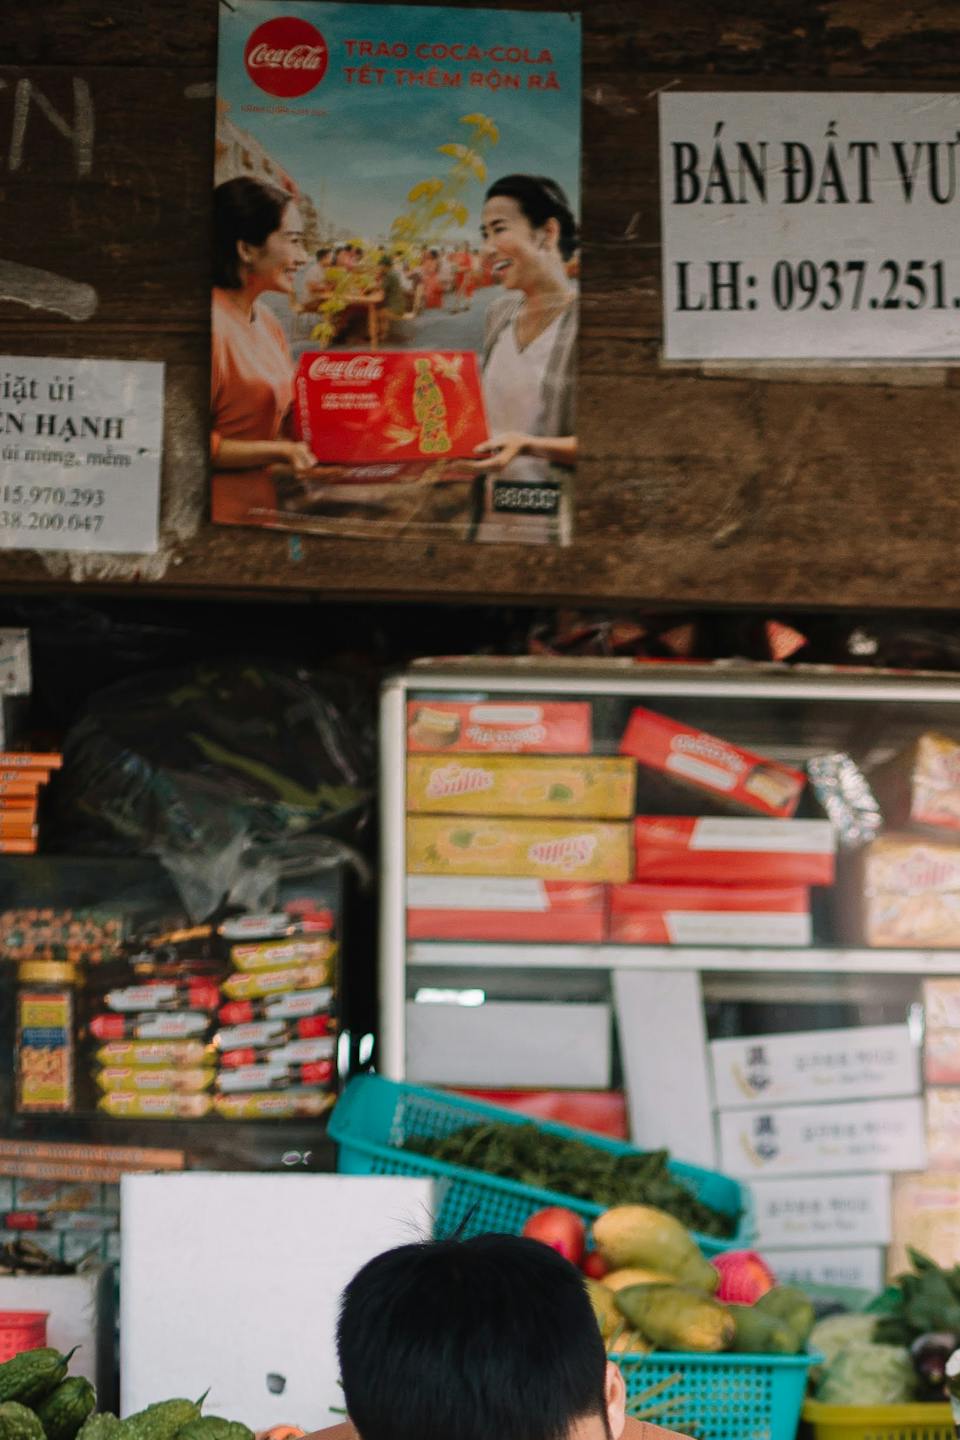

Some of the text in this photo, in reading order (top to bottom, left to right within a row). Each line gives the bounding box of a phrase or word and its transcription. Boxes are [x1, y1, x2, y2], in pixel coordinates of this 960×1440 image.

[344, 40, 554, 64] TRAO COCA-COLA
[343, 64, 385, 86] TẾT
[671, 121, 767, 206] BÁN
[782, 121, 878, 206] ĐẤT
[674, 260, 759, 312] LH:
[0, 373, 38, 405] iặt
[35, 413, 124, 443] HẠNH
[0, 485, 105, 508] 15.970.293
